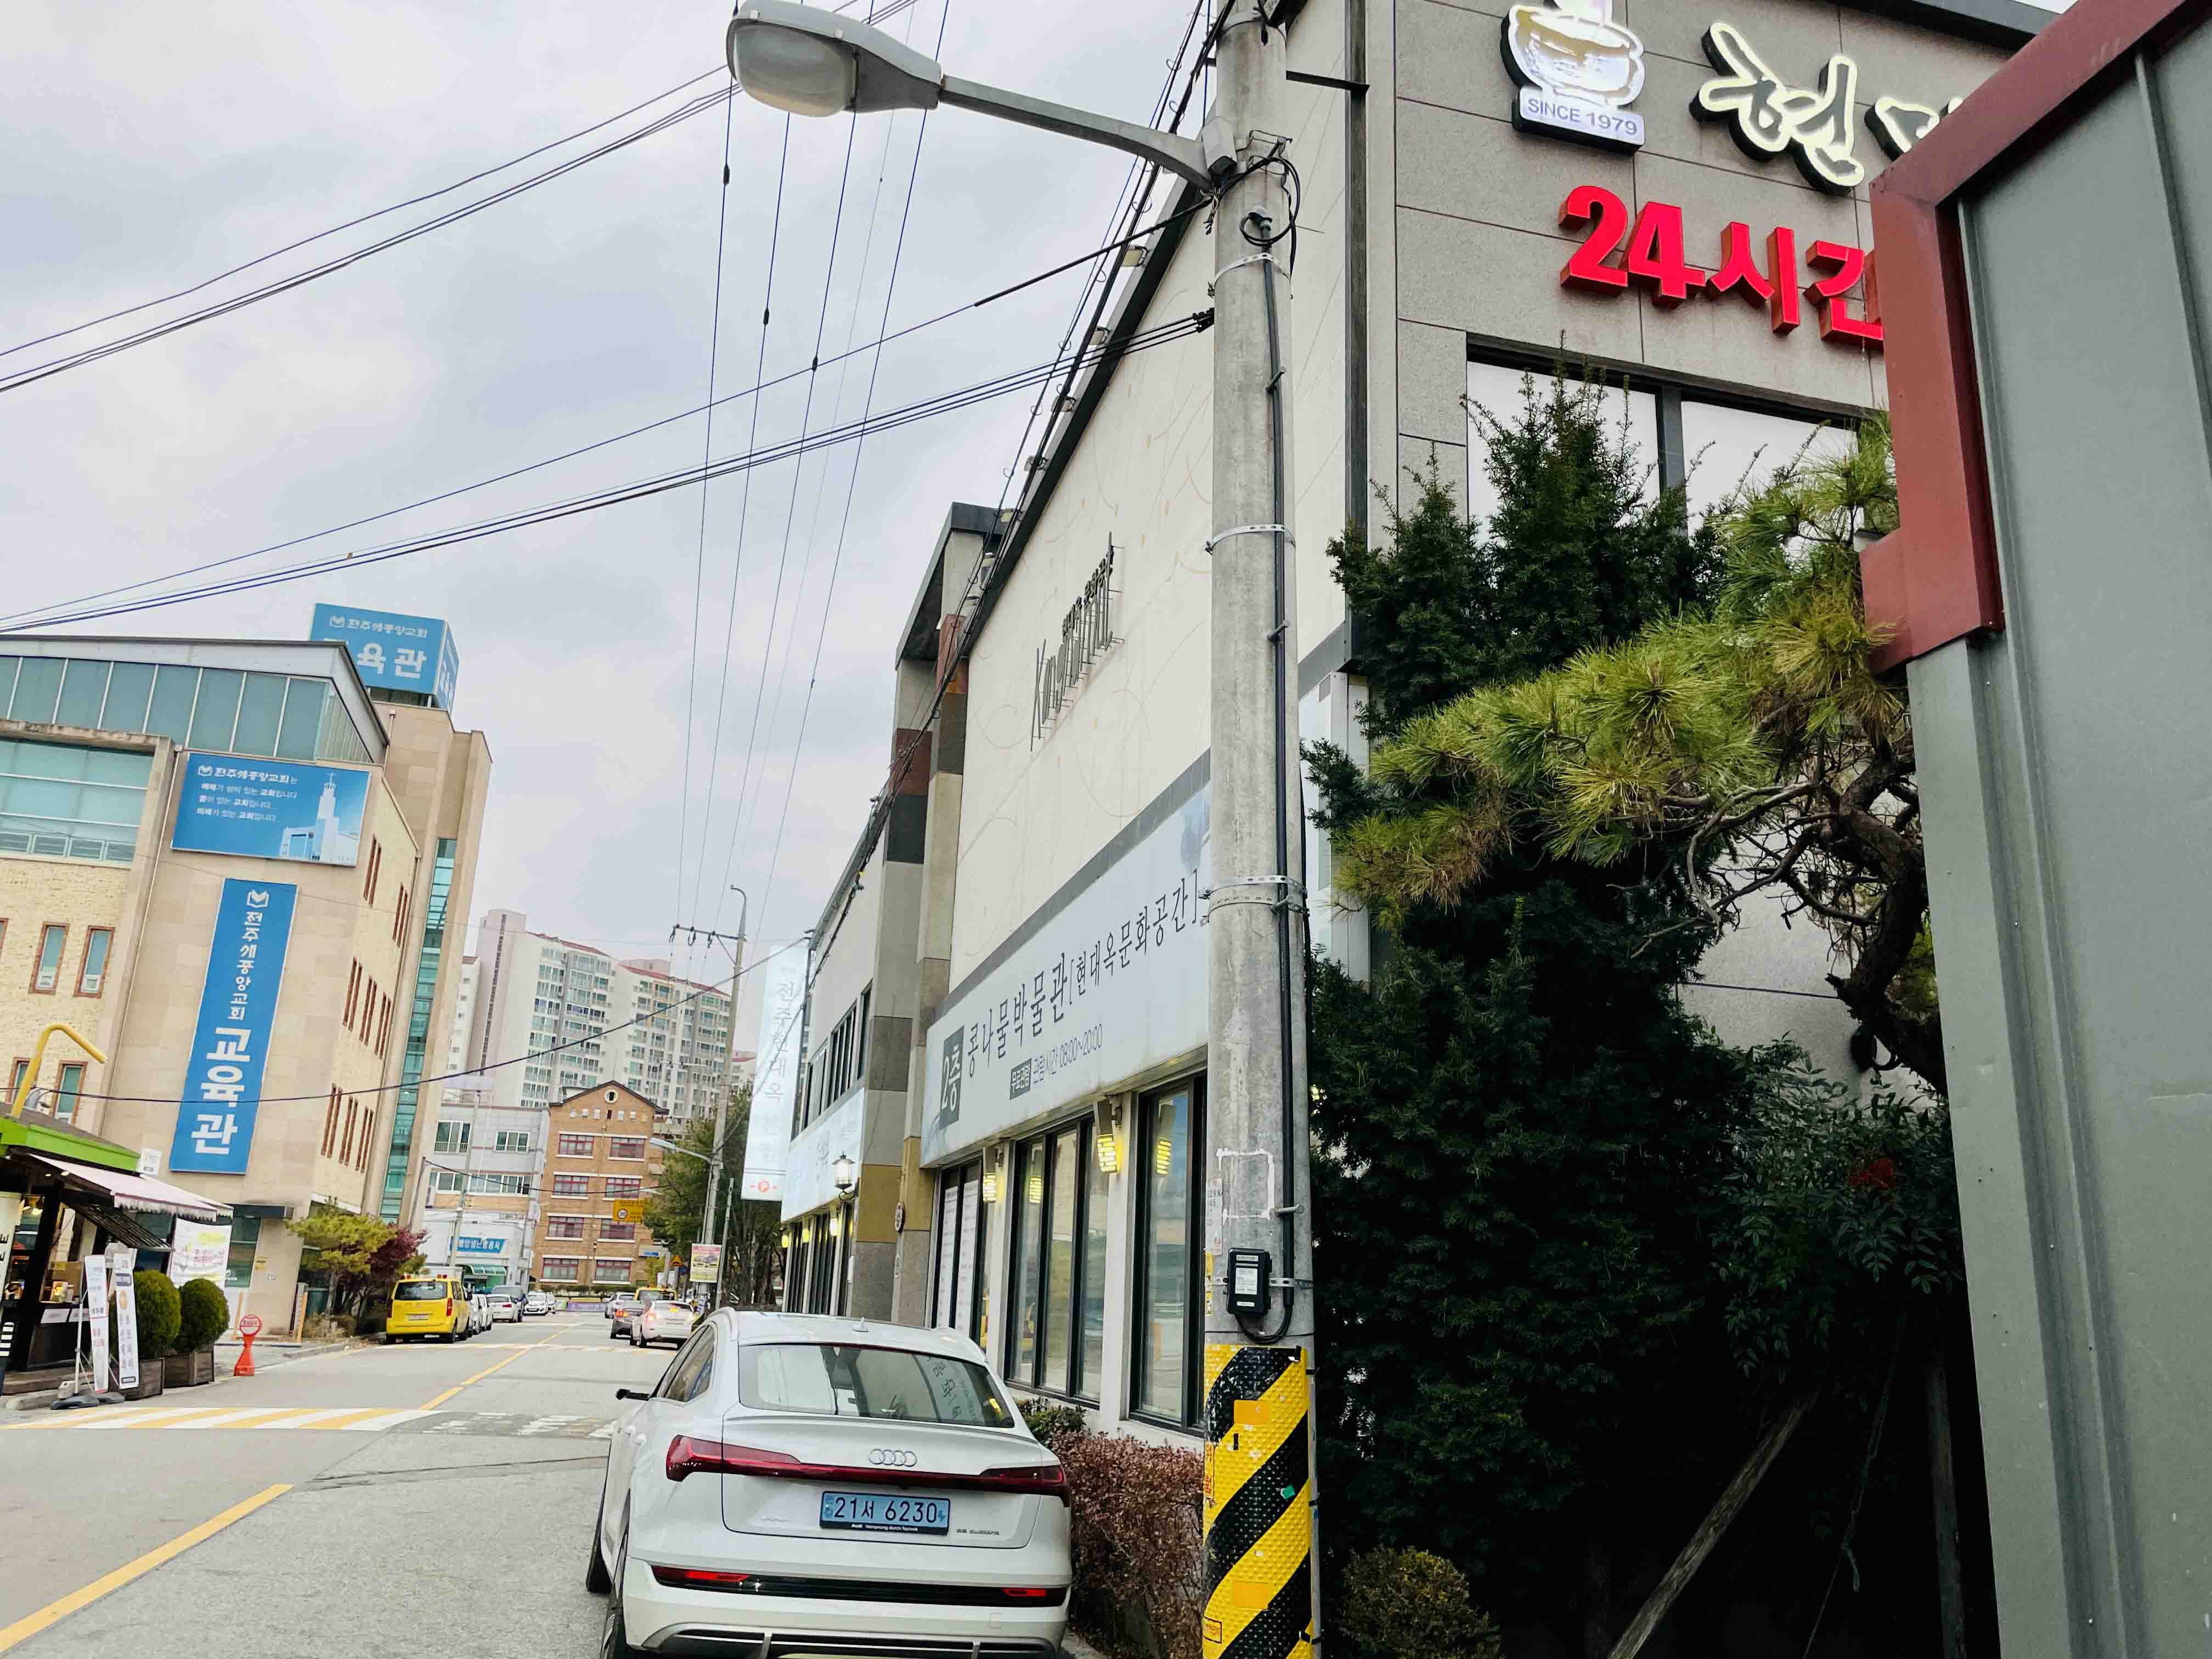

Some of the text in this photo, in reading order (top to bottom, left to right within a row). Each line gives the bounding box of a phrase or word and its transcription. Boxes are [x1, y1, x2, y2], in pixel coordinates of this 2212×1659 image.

[1527, 98, 1638, 136] SINCE 1979
[1559, 185, 1884, 351] 24시간
[323, 638, 427, 679] 육관
[228, 911, 263, 1021] 전주새중앙교회
[191, 1027, 251, 1155] 교육관
[941, 1044, 961, 1111] 2층
[834, 1497, 937, 1523] 21서 6230
